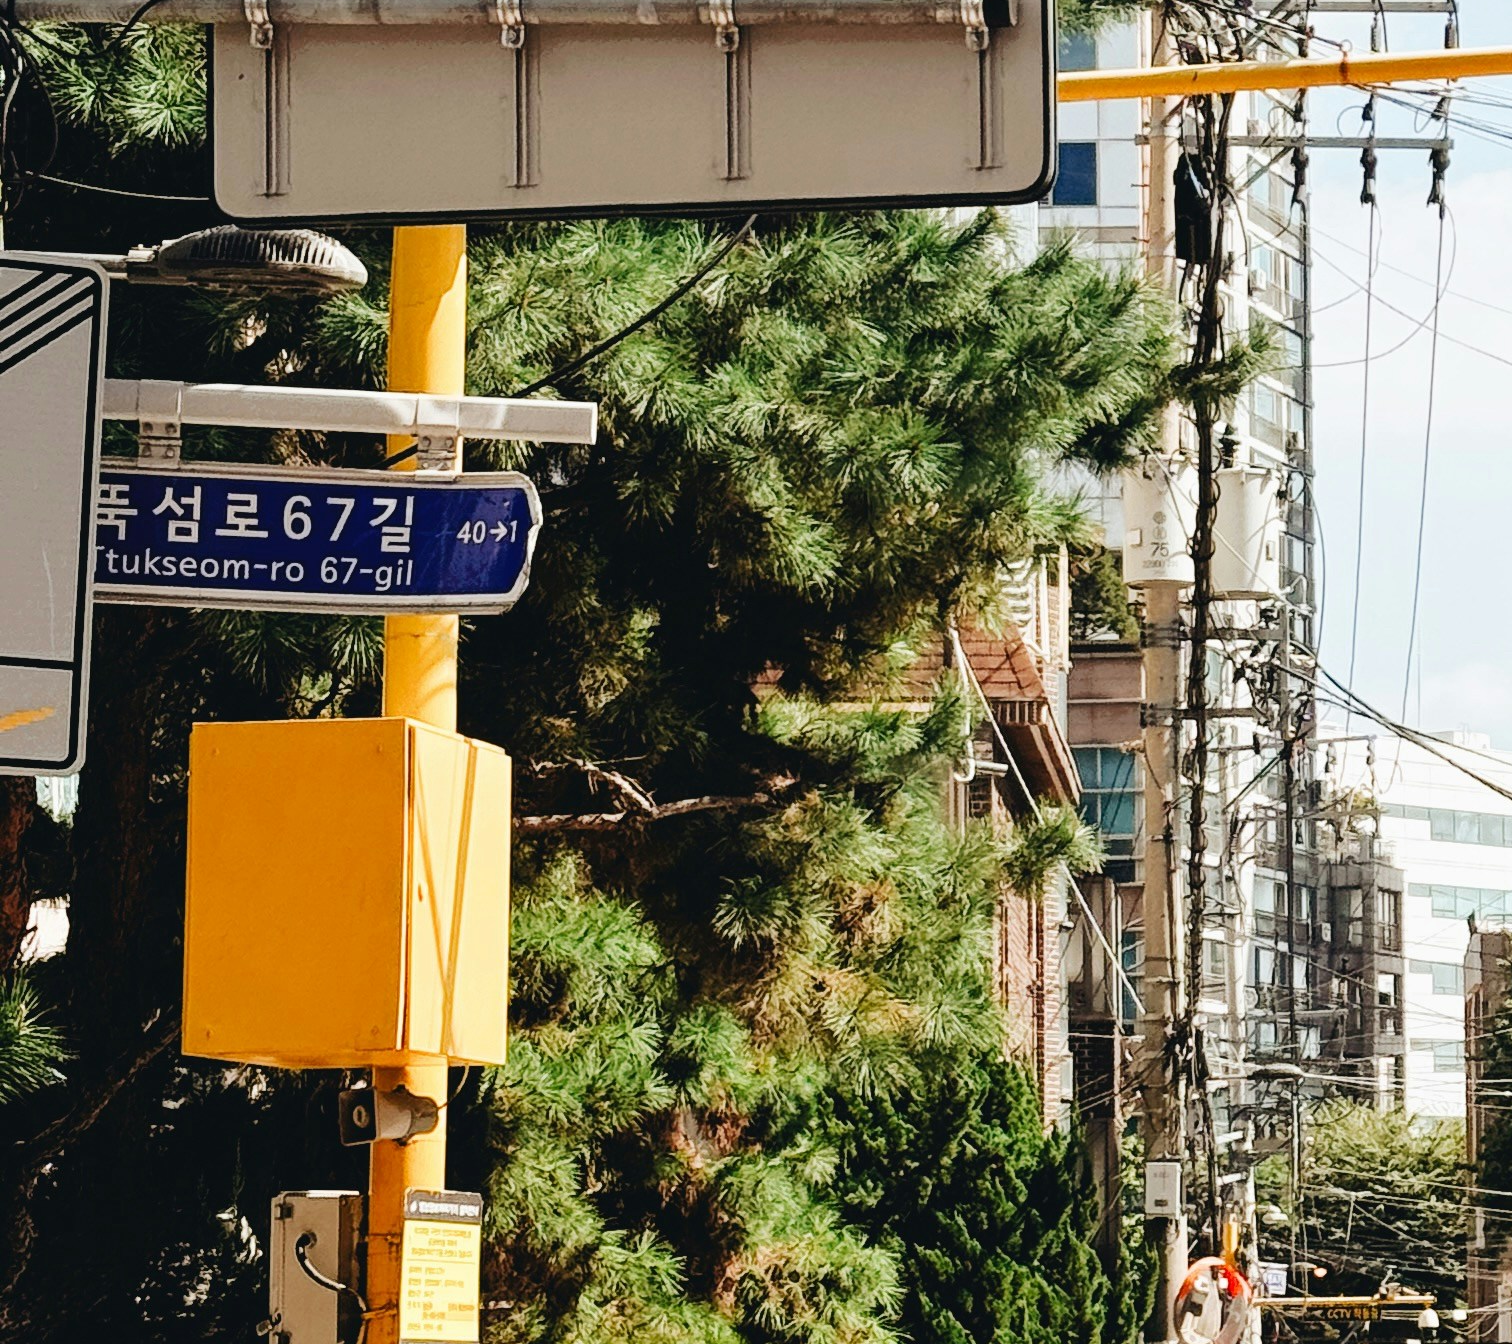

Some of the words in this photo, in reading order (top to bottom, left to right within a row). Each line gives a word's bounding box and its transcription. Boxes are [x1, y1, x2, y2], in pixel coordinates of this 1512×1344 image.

[1151, 542, 1169, 556] 75
[96, 545, 304, 583] tukseom-ro
[320, 556, 413, 591] 67-gil
